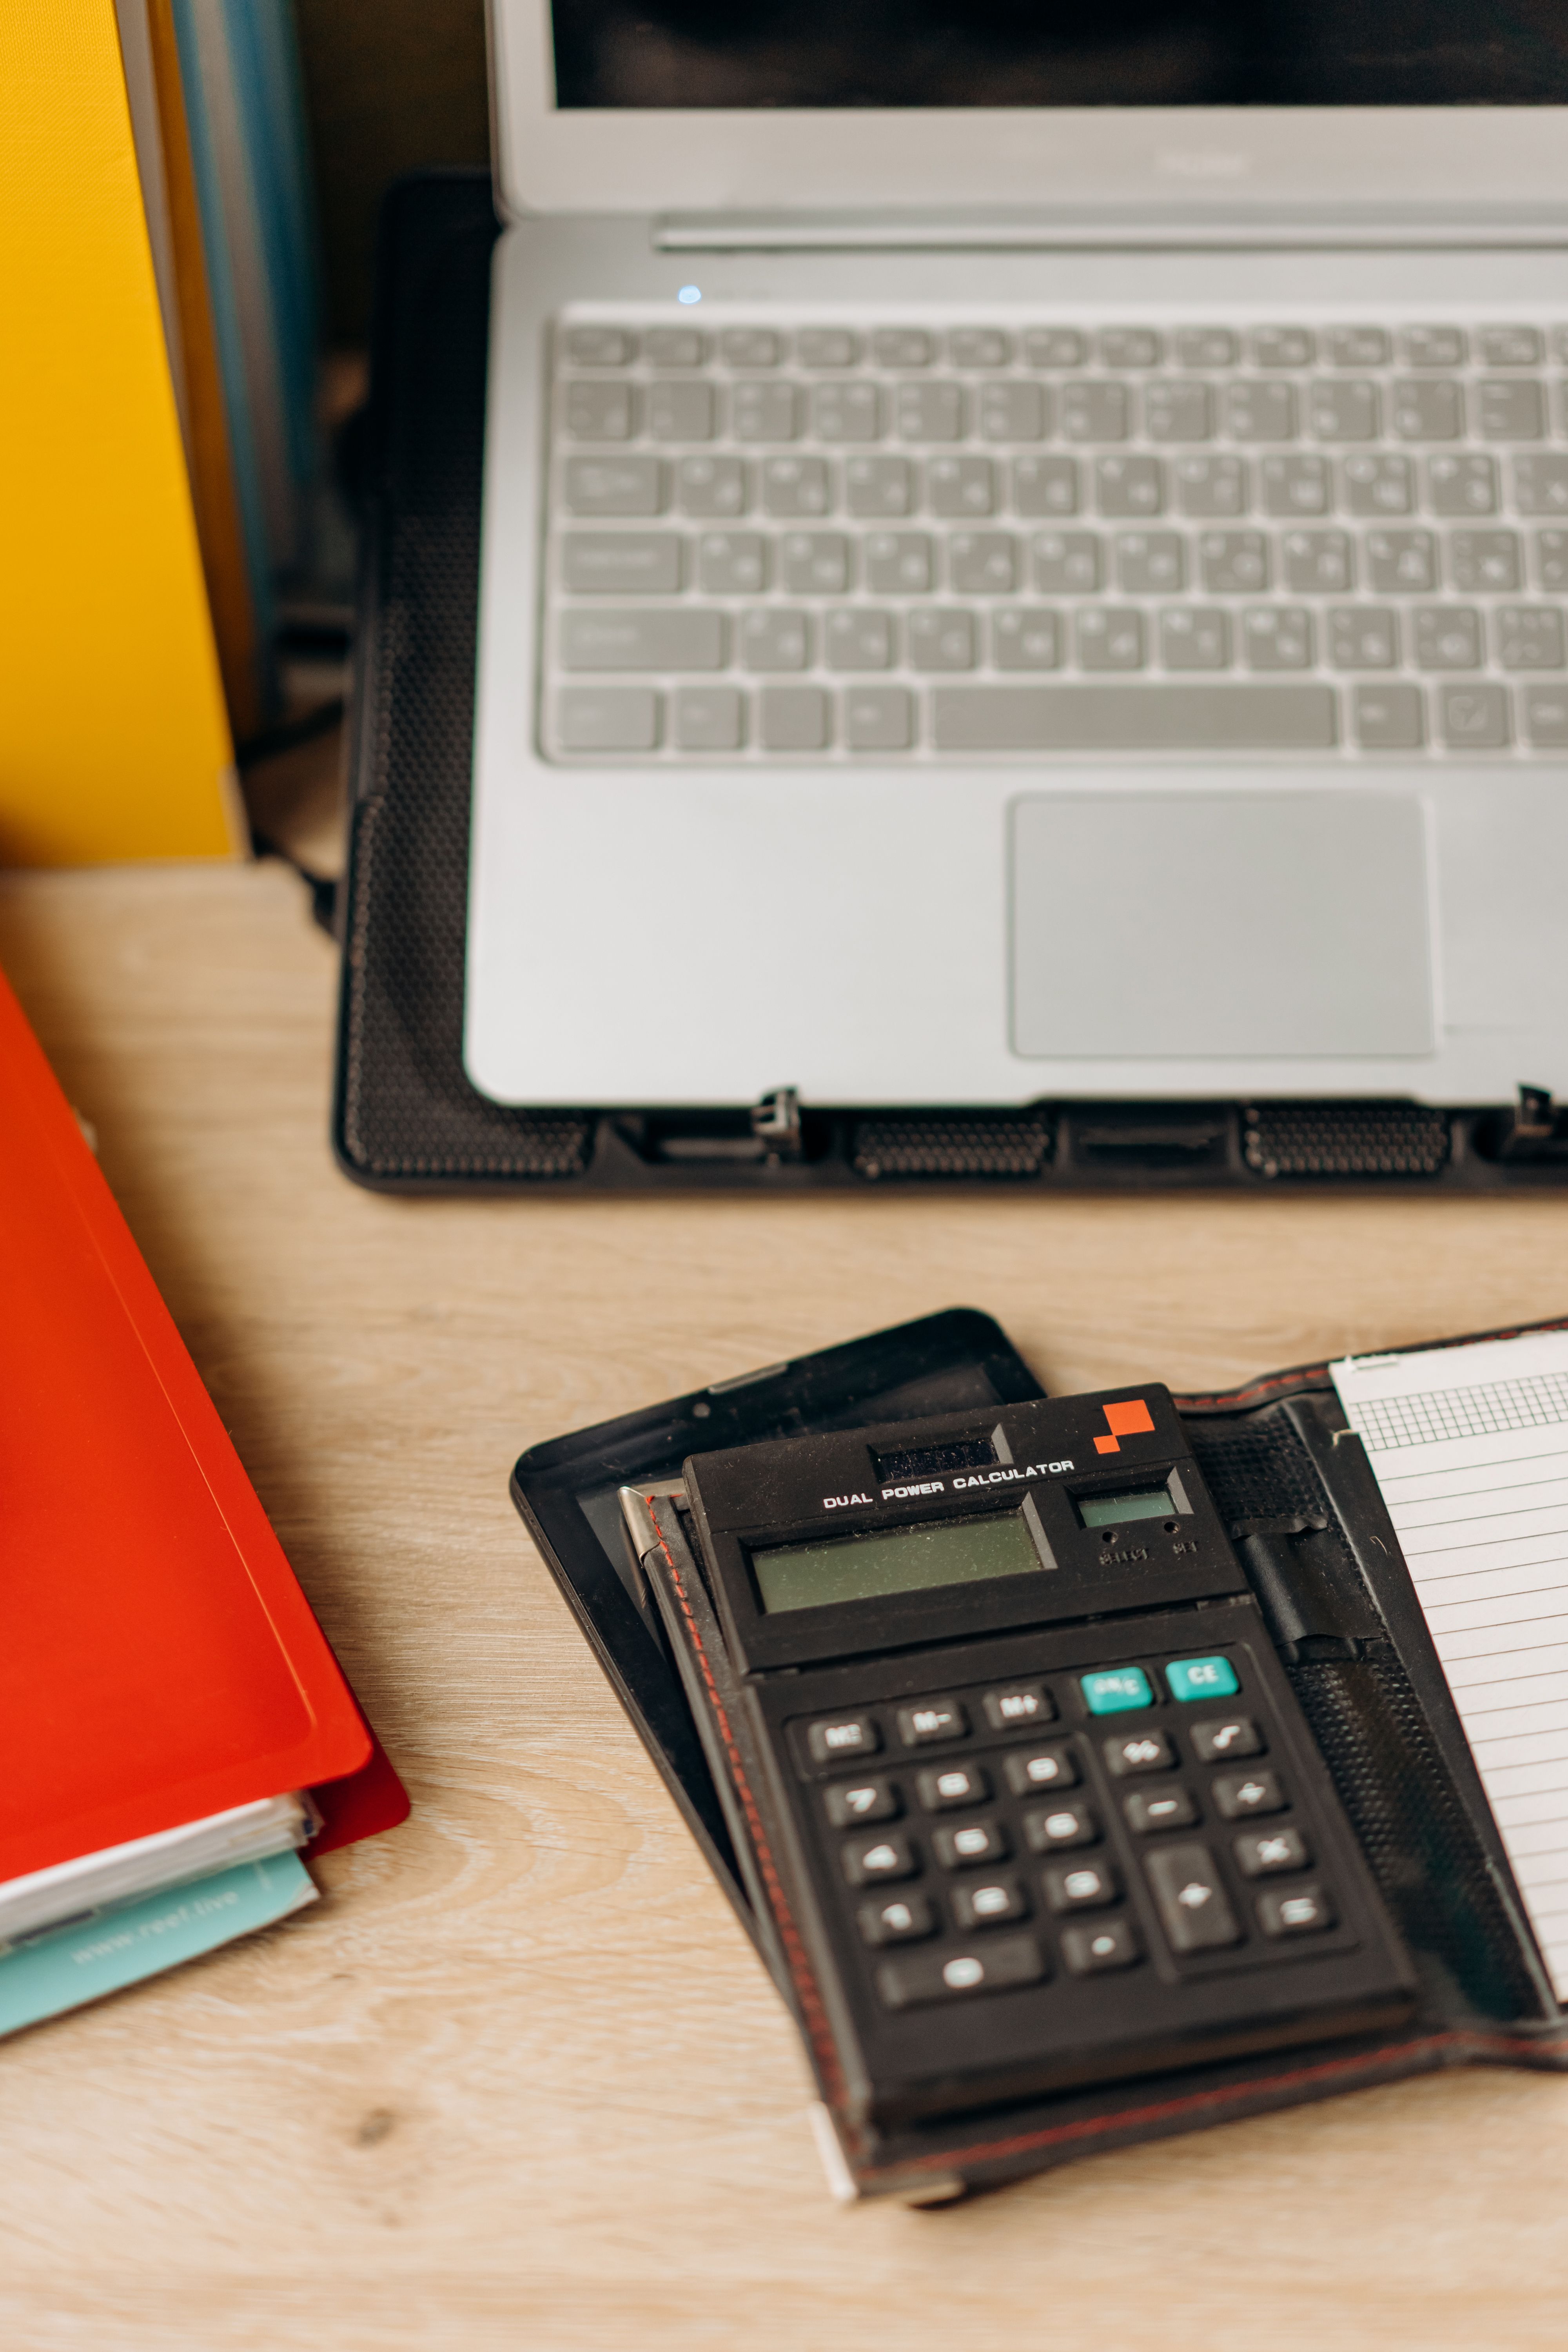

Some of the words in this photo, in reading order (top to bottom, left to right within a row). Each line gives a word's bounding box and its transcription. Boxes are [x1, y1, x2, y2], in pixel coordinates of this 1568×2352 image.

[823, 1493, 873, 1509] DUAL
[882, 1481, 944, 1500] POWER
[953, 1460, 1075, 1490] CALCULATOR
[1187, 1664, 1219, 1685] CE
